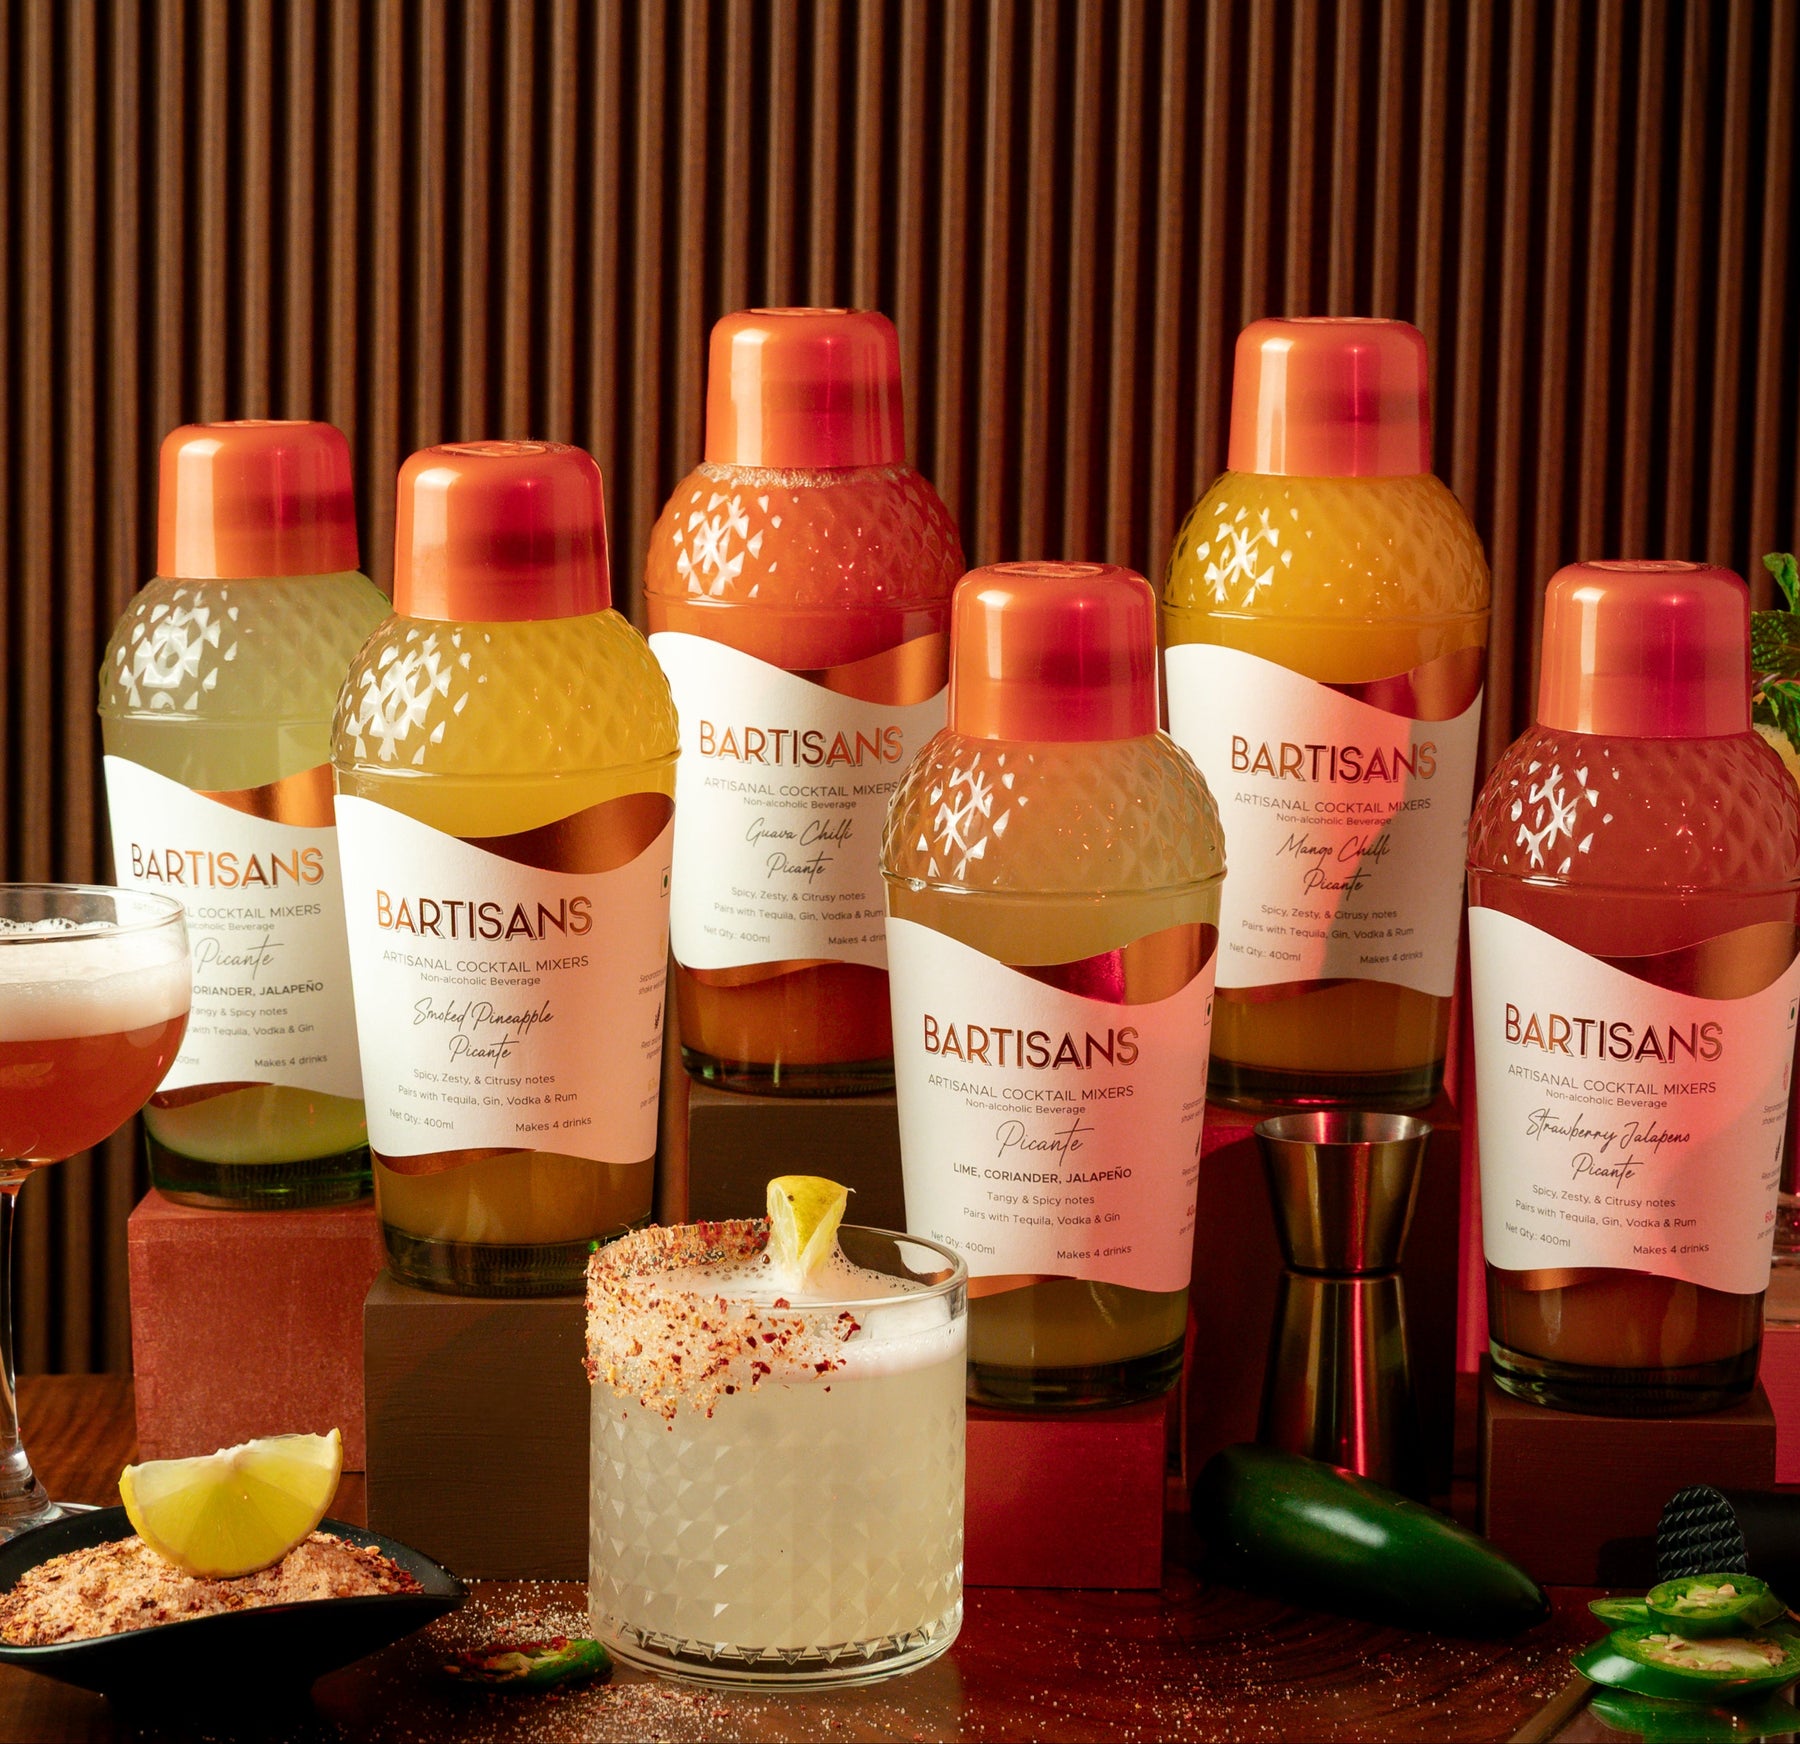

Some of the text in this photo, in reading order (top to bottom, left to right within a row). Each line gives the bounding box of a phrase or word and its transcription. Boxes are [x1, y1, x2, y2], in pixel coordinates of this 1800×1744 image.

[700, 720, 904, 768] BARTISANS
[1232, 735, 1437, 784] BARTISANS
[704, 776, 899, 797] ARTISANAL COCKTAIL MIXERS
[743, 797, 856, 810] Non-alcoholic Beverage
[1234, 792, 1431, 813] ARTISANAL COCKTAIL MIXERS
[1276, 812, 1392, 826] Non-alcoholic Beverage
[745, 817, 853, 848] Guava Chilli
[1276, 833, 1391, 869] Mango Chilli
[131, 843, 324, 889] BARTISANS
[766, 851, 834, 884] Picante
[1303, 867, 1372, 901] Picante
[731, 887, 866, 903] Spicy, Zesty, & Citrusy notes
[198, 907, 265, 919] COCKTAIL
[270, 904, 321, 917] MIXERS
[376, 889, 593, 941] BARTISANS
[714, 902, 884, 921] Pairs with Tequila, Gin, Vodka & Rum
[1261, 905, 1288, 917] Spicy,
[1291, 908, 1321, 920] Zesty,
[1334, 910, 1369, 921] Citrusy
[1372, 909, 1397, 918] notes
[228, 922, 275, 931] Beverage
[703, 924, 718, 936] Net
[740, 932, 771, 944] 400ml
[1242, 920, 1414, 940] Pairs with Tequila, Gin, Vodka & Rum
[828, 933, 886, 945] Makes 4 drin
[194, 934, 285, 980] Picante
[383, 950, 589, 973] ARTISANAL COCKTAIL MIXERS
[1229, 942, 1244, 953] Net
[1269, 950, 1301, 961] 400ml
[1360, 951, 1423, 964] Makes 4 drinks
[192, 980, 324, 997] ORIANDER, JALAPEÑO
[421, 973, 541, 987] Non-alcoholic Beverage
[220, 1008, 227, 1016] &
[230, 1008, 256, 1018] Spicy
[260, 1007, 288, 1016] notes
[413, 997, 554, 1035] Smoked Pineapple
[213, 1027, 250, 1037] Tequila,
[253, 1026, 285, 1035] Vodka
[288, 1025, 295, 1033] &
[298, 1024, 314, 1032] Gin
[1505, 1003, 1723, 1063] BARTISANS
[449, 1033, 520, 1069] Picante
[924, 1014, 1139, 1070] BARTISANS
[255, 1055, 327, 1068] Makes 4 drinks
[413, 1068, 556, 1086] Spicy, Zesty, & Citrusy notes
[928, 1073, 1134, 1102] ARTISANAL COCKTAIL MIXERS
[1508, 1064, 1717, 1095] ARTISANAL COCKTAIL MIXERS
[398, 1085, 578, 1106] Pairs with Tequila, Gin, Vodka & Rum
[1546, 1089, 1668, 1109] Non-alcoholic Beverage
[965, 1098, 1086, 1115] Non-alcoholic Beverage
[389, 1108, 404, 1120] Net
[424, 1117, 454, 1130] 400ml
[515, 1116, 592, 1132] Makes 4 drinks
[1526, 1108, 1690, 1154] Strawberry Jalapeno
[995, 1118, 1095, 1167] Picante
[953, 1163, 1132, 1184] LIME, CORIANDER, JALAPEÑO
[1572, 1153, 1644, 1189] Picante
[987, 1192, 1095, 1207] Tangy & Spicy notes
[1532, 1185, 1676, 1208] Spicy, Zesty, & Citrusy notes
[963, 1207, 1120, 1227] Pairs with Tequila, Vodka & Gin
[1515, 1200, 1697, 1228] Pairs with Tequila, Gin, Vodka & Rum
[930, 1230, 944, 1242] Net
[965, 1241, 996, 1255] 400ml
[1505, 1222, 1519, 1233] Net
[1540, 1234, 1571, 1247] 400ml
[1057, 1244, 1132, 1260] Makes 4 drinks
[1633, 1243, 1710, 1255] Makes 4 drinks
